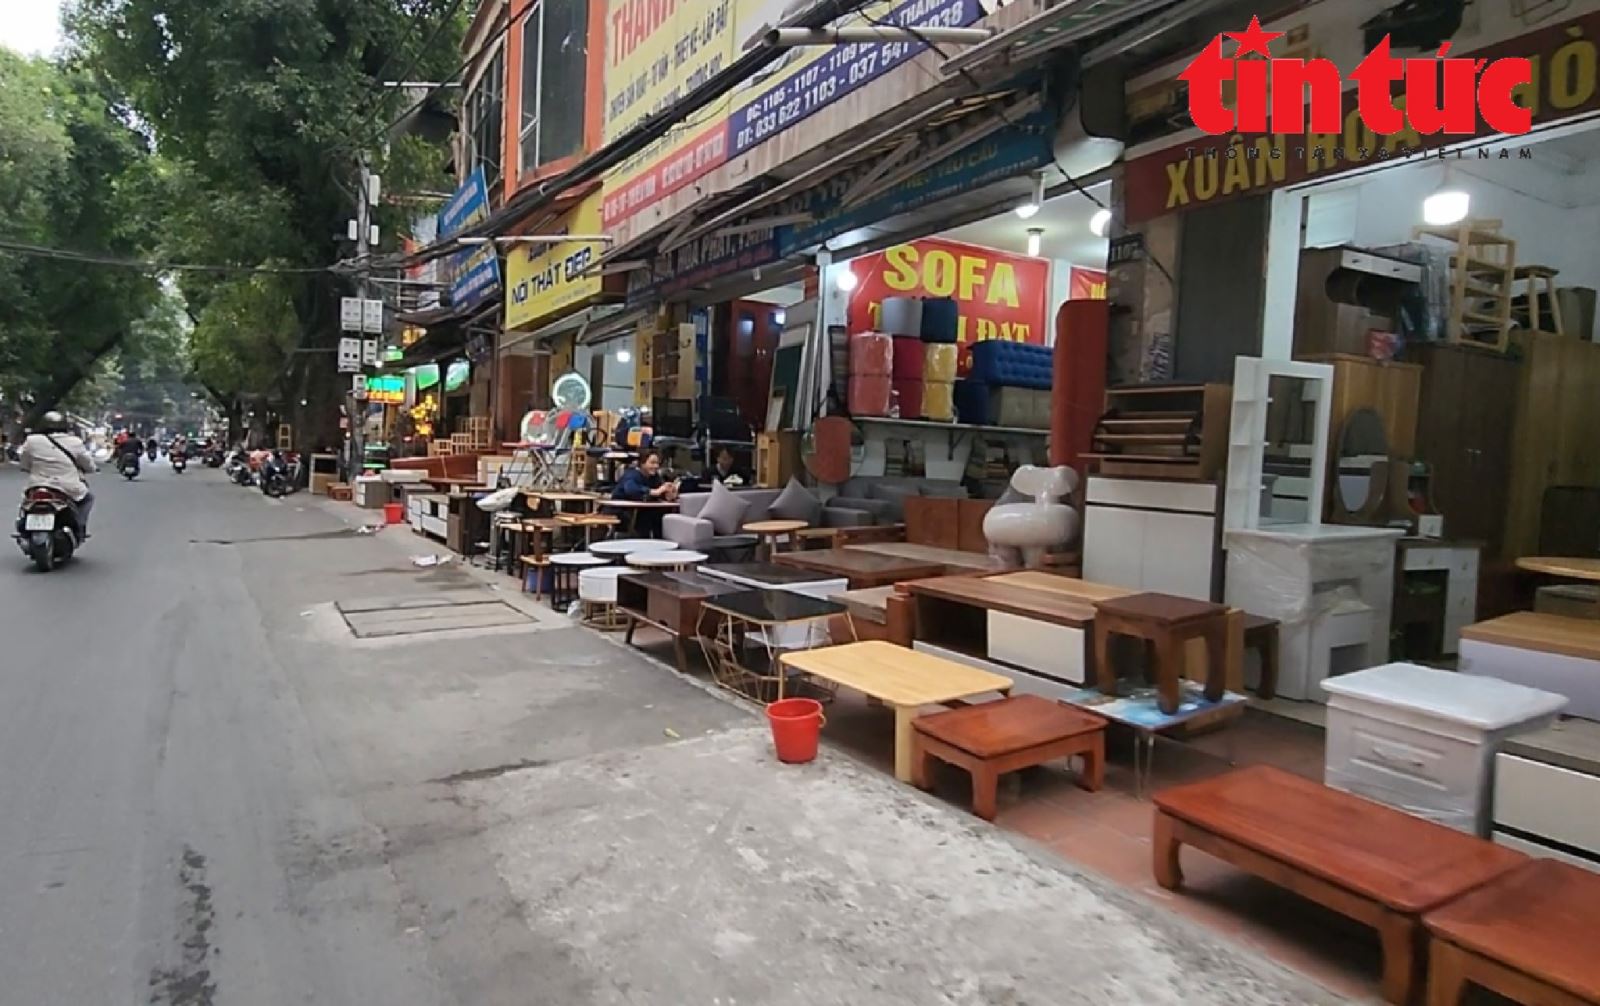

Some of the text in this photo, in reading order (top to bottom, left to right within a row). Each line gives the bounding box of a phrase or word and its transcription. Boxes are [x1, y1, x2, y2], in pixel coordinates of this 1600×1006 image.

[755, 112, 776, 138] 033
[778, 96, 800, 123] 622
[804, 75, 836, 110] 1103
[849, 51, 878, 84] 037
[764, 87, 785, 111] 1105
[795, 66, 818, 92] 1107
[829, 43, 857, 70] 1109
[1166, 134, 1286, 209] XUÂN
[882, 244, 1021, 309] SOFA
